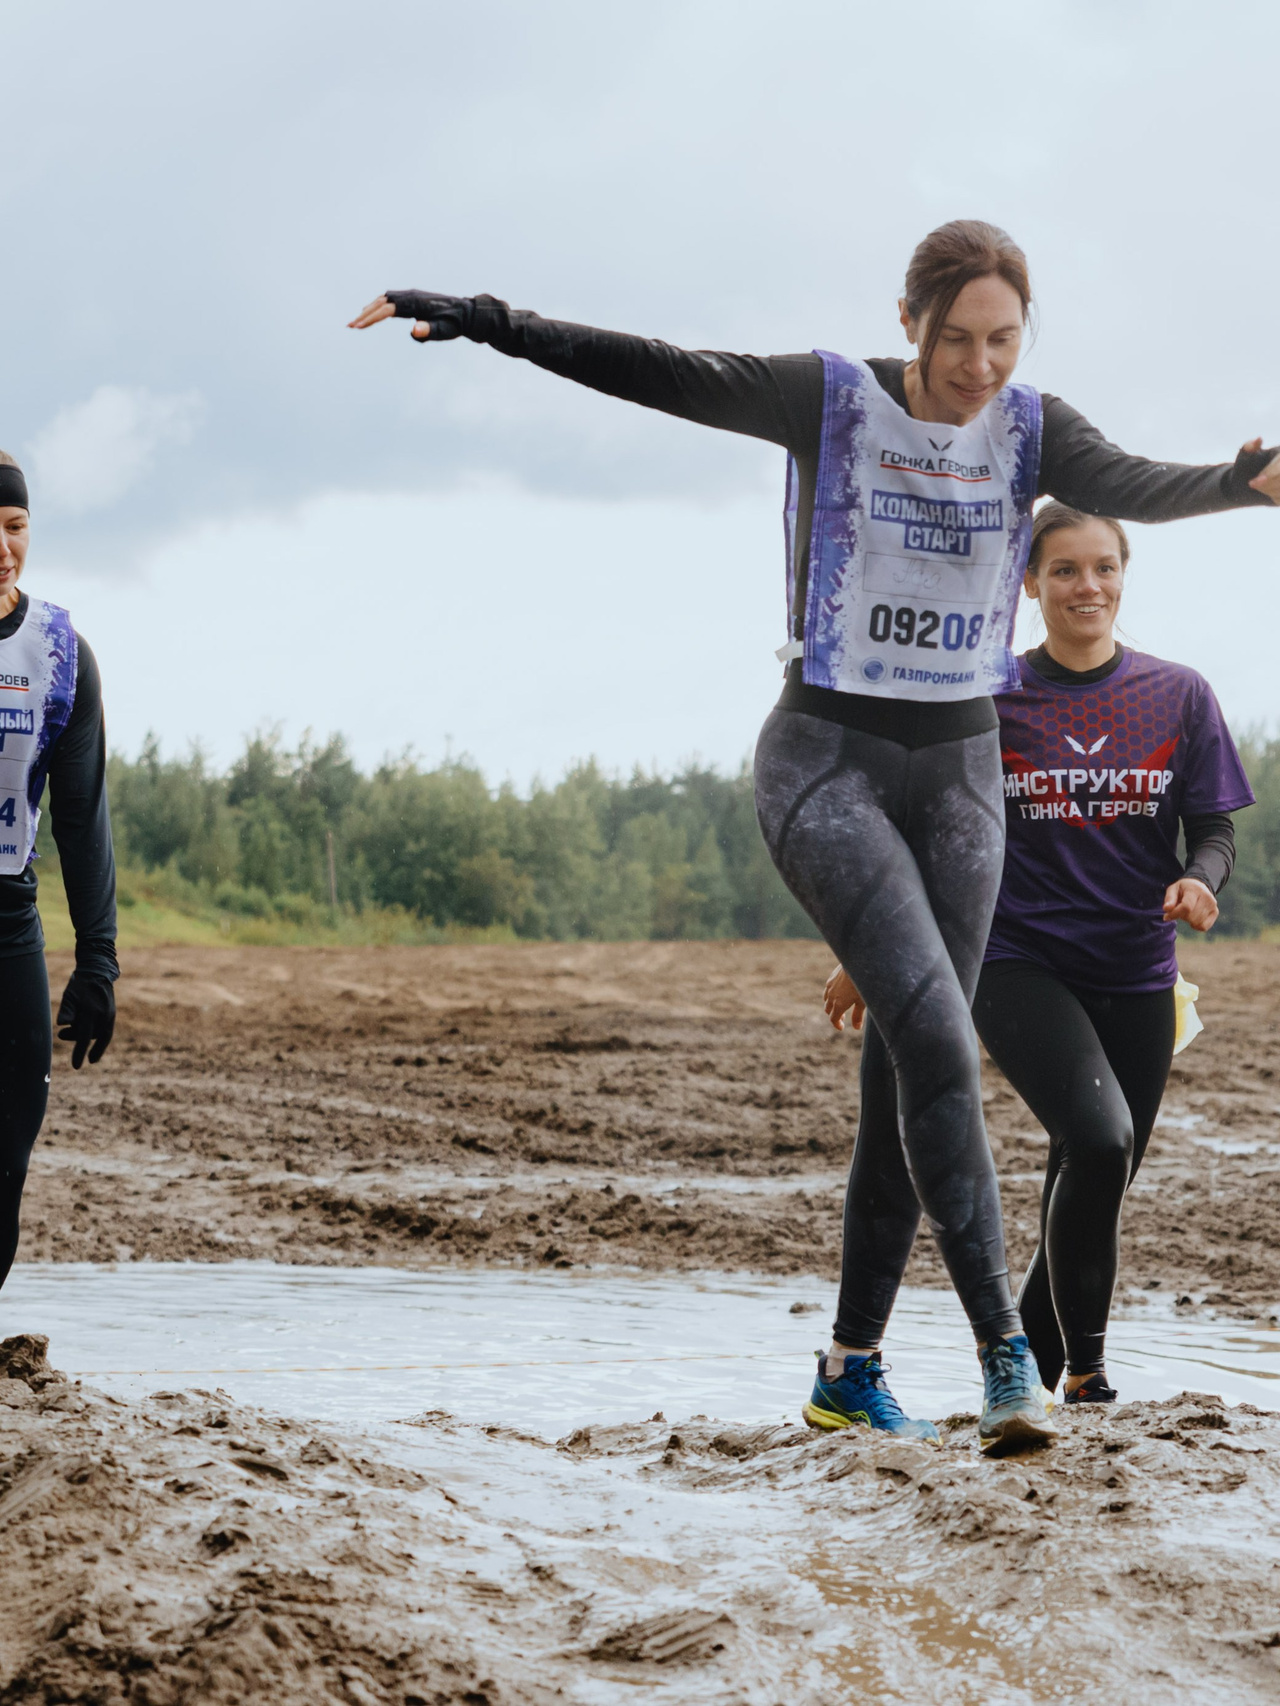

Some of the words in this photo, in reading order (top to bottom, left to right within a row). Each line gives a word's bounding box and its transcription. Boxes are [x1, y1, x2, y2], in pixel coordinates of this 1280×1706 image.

[881, 449, 935, 471] ГОНКА
[939, 458, 990, 478] ГЕРОЕВ
[873, 494, 1001, 529] КОМАНДНЫЙ
[908, 525, 968, 553] СТАРТ
[869, 603, 985, 651] 09208
[892, 665, 977, 685] ГАЗПРОМБАНК
[1019, 801, 1082, 820] ГОНКА
